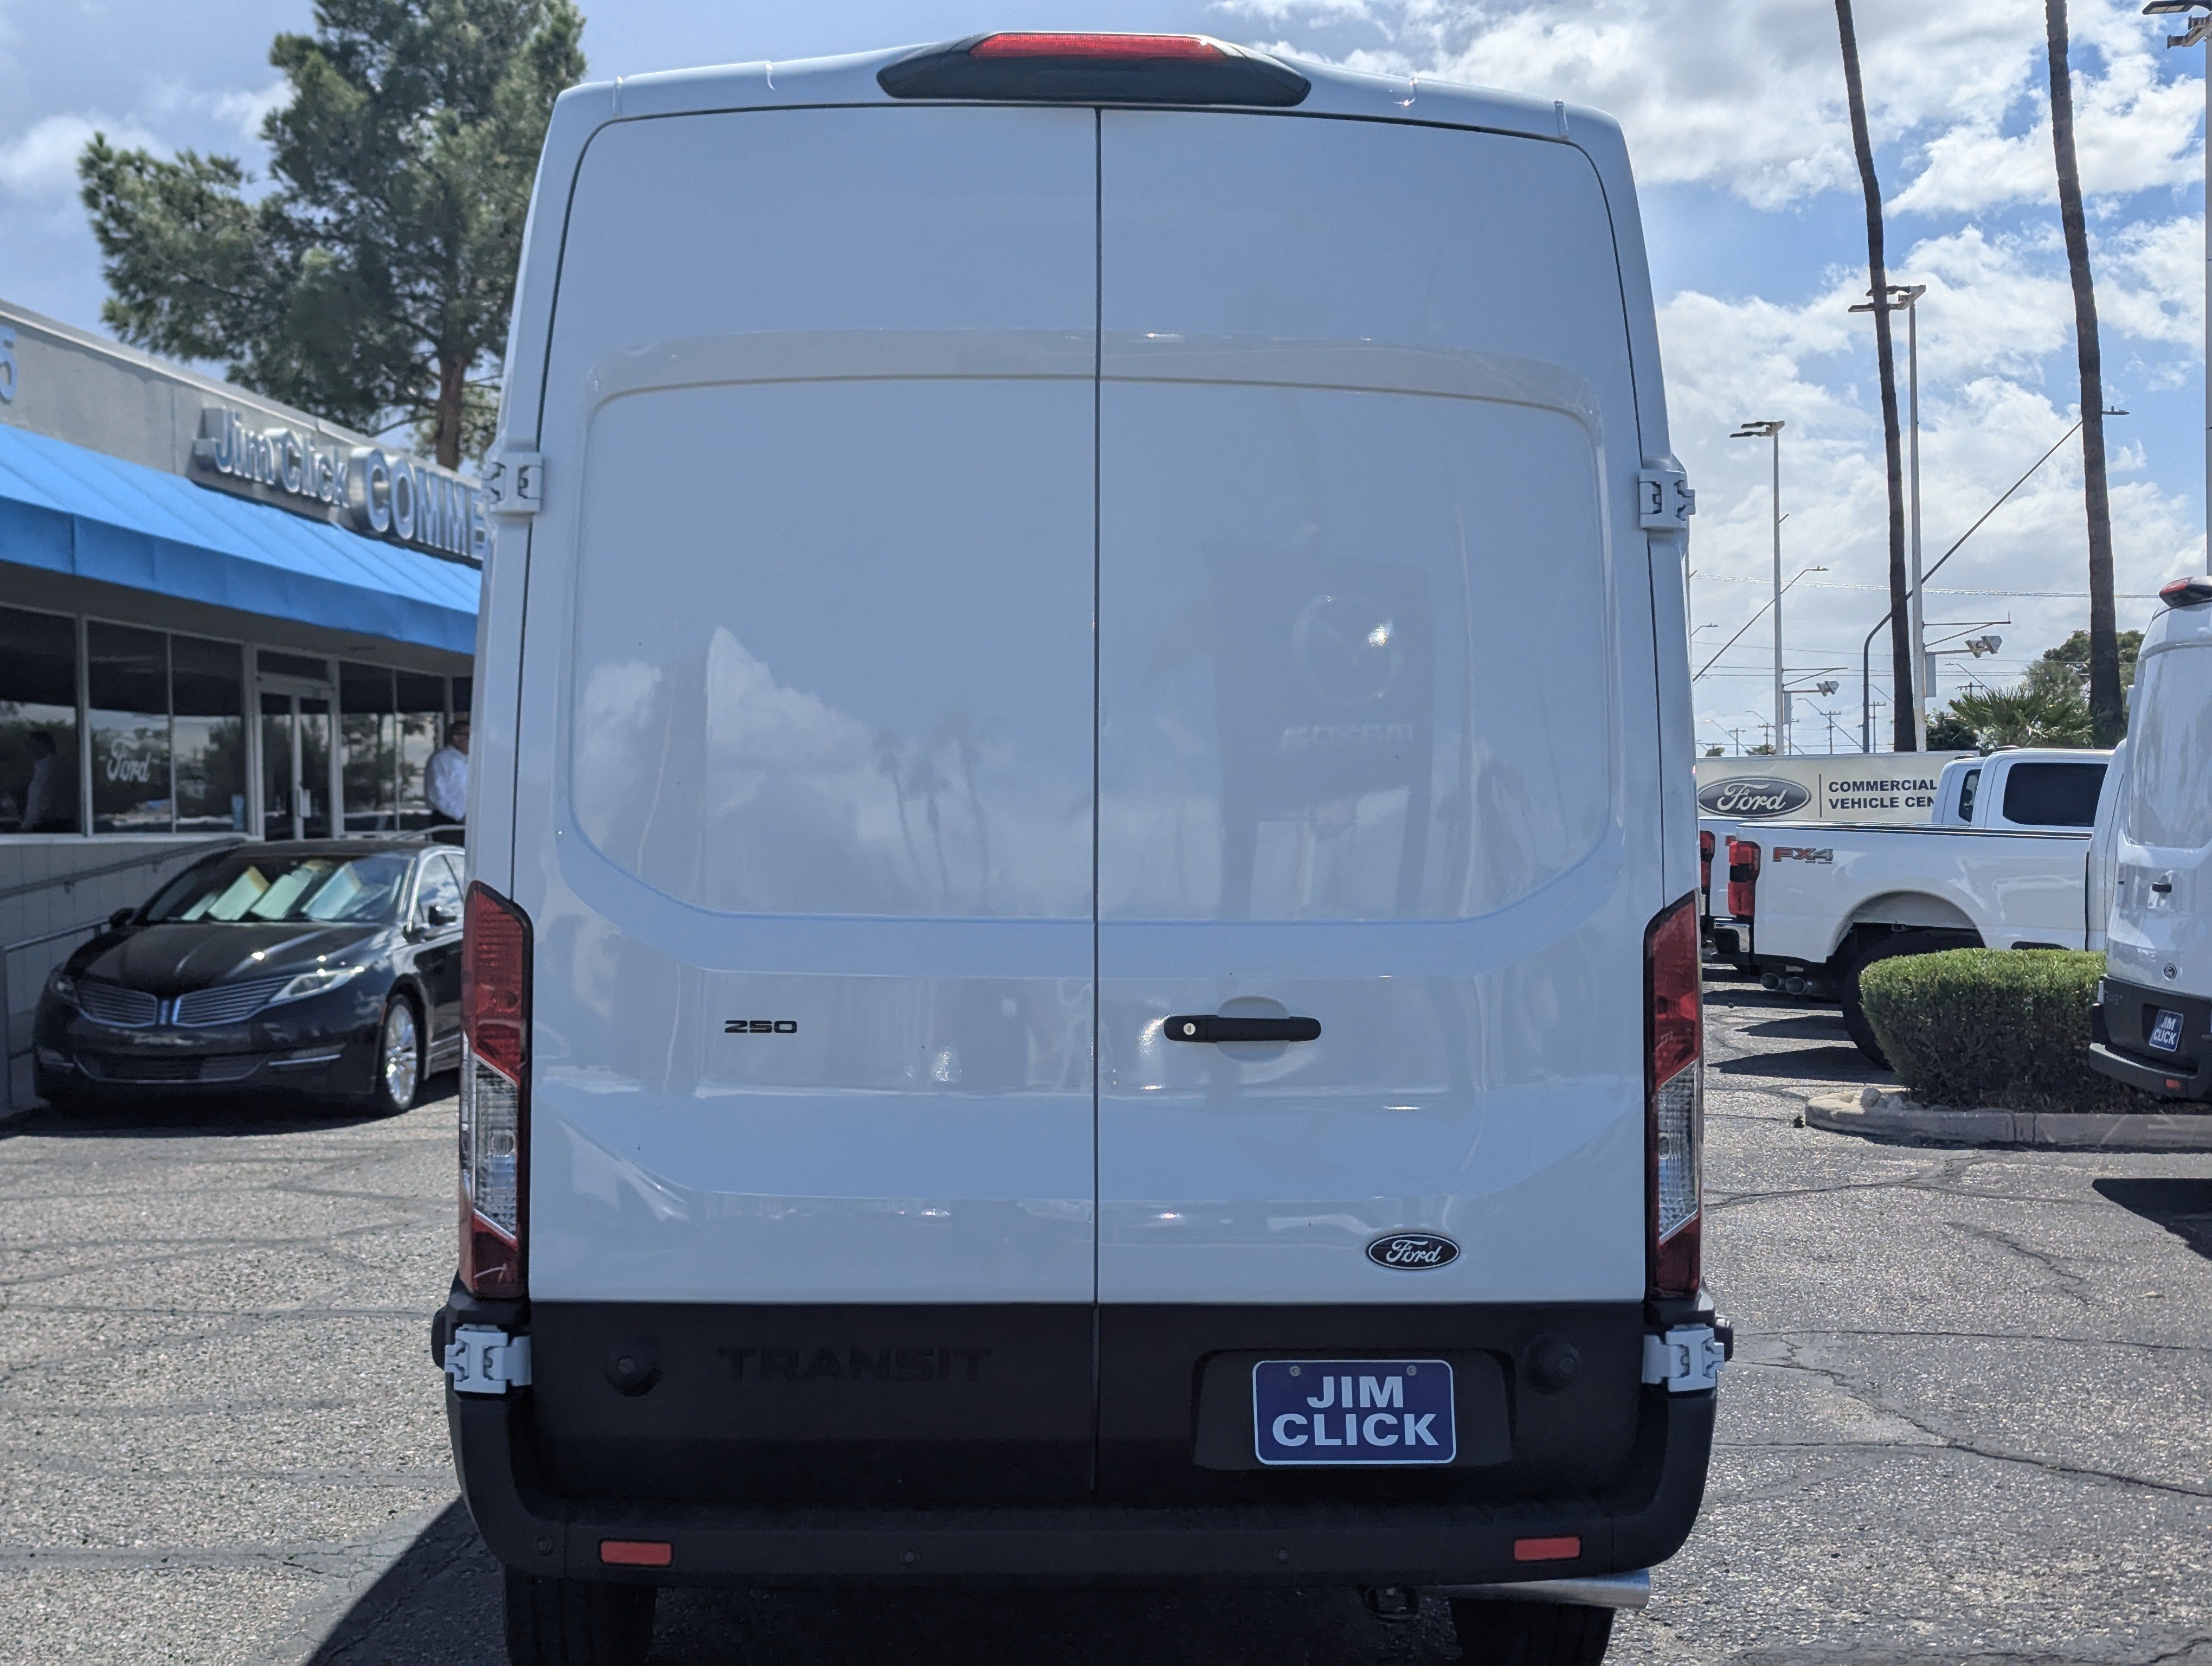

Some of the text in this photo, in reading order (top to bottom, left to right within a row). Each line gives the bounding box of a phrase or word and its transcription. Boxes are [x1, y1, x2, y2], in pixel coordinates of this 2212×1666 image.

[210, 404, 275, 485] Jim
[280, 428, 350, 509] Click
[107, 738, 151, 783] Ford
[1717, 783, 1789, 811] Ford
[1829, 779, 1938, 792] COMMERCIAL
[1829, 797, 1899, 809] VEHICLE
[1773, 847, 1834, 862] FX4
[724, 1020, 798, 1034] 250
[2160, 1016, 2176, 1030] JIM
[2153, 1028, 2177, 1046] CLICK
[1386, 1239, 1442, 1263] Ford
[717, 1345, 993, 1382] TRANSIT
[1307, 1376, 1404, 1408] JIM
[1272, 1413, 1439, 1446] CLICK
